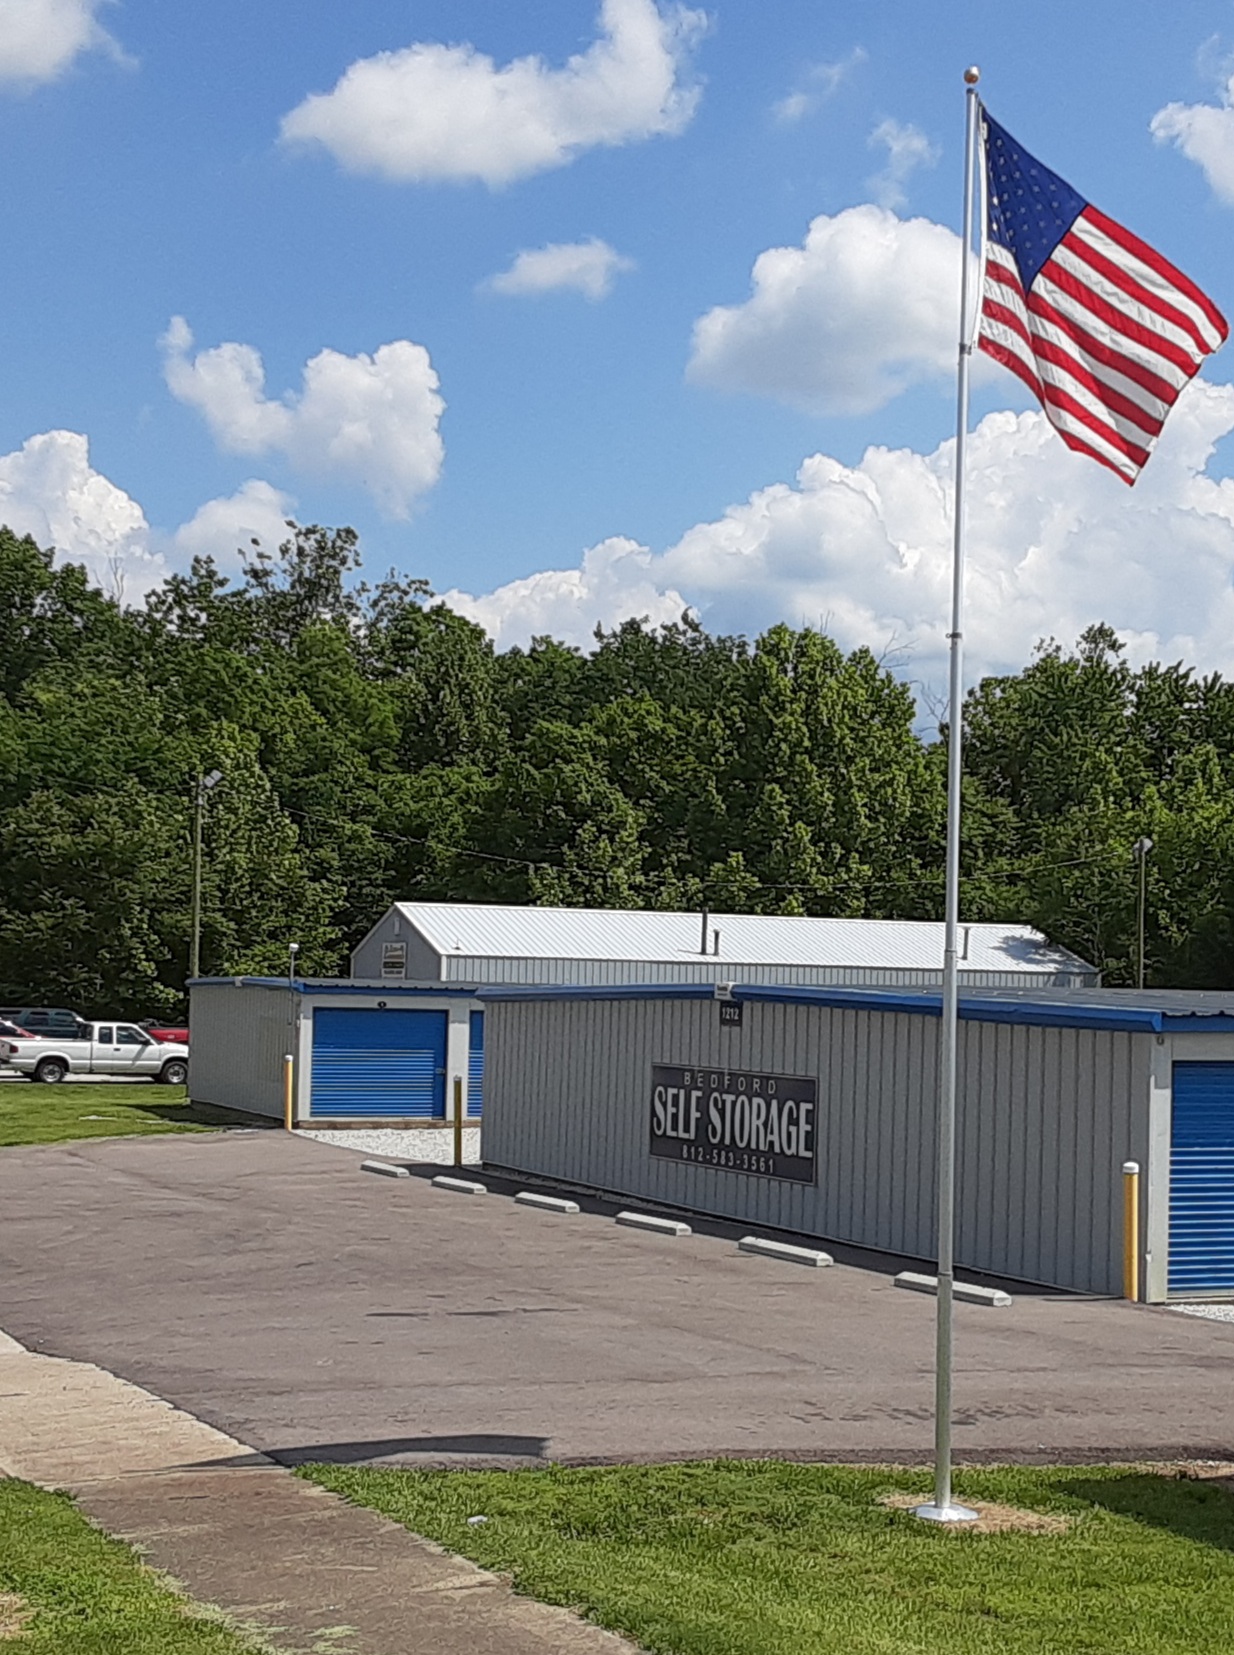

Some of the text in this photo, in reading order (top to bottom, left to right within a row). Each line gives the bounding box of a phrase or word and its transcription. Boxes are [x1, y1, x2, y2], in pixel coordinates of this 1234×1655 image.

[722, 1007, 740, 1020] 1212
[684, 1072, 776, 1094] BEDFORD
[653, 1085, 814, 1158] SELF STORAGE
[682, 1145, 774, 1174] 812-583-3561
